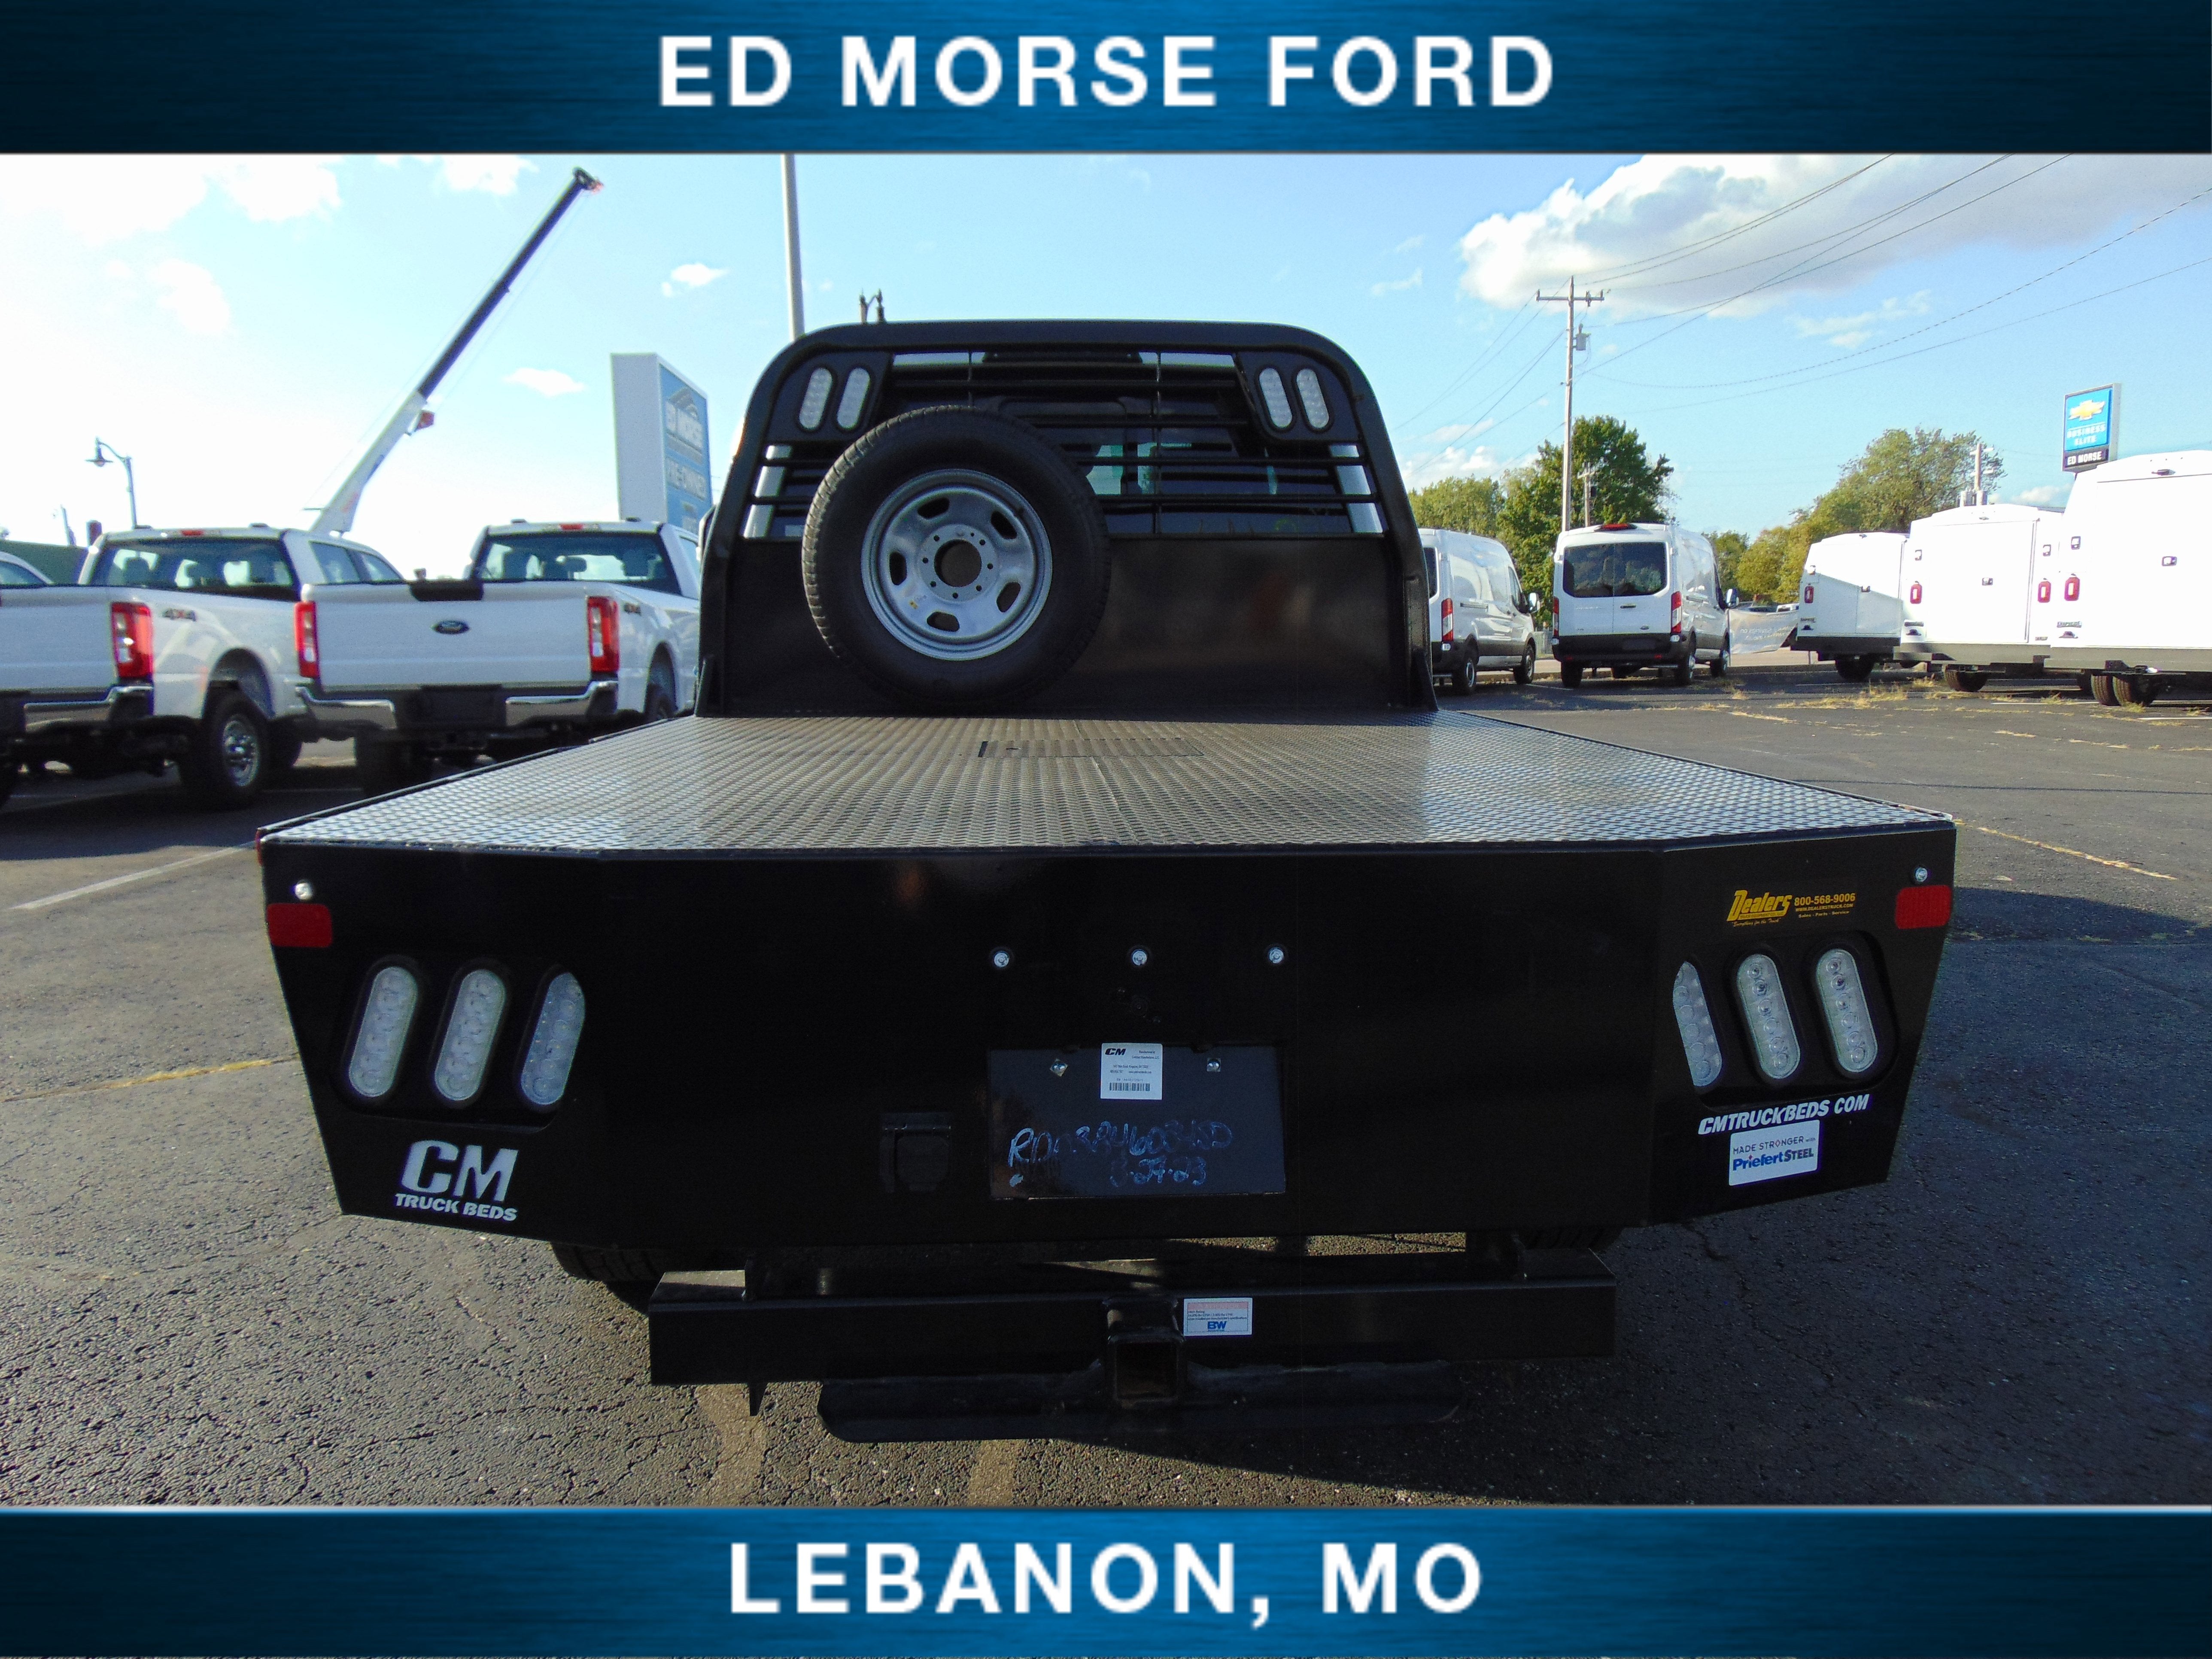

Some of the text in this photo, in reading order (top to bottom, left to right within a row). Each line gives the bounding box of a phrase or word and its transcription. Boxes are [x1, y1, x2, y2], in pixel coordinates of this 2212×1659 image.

[2067, 423, 2106, 438] BUSINESS
[2075, 435, 2097, 445] ELITE
[2067, 451, 2103, 465] ED MORSE
[1726, 890, 1793, 921] Dealers
[1794, 893, 1856, 906] 800-568-9006
[1733, 1143, 1756, 1155] MADE
[401, 1139, 519, 1202] CM
[395, 1193, 518, 1221] TRUCK BEDS
